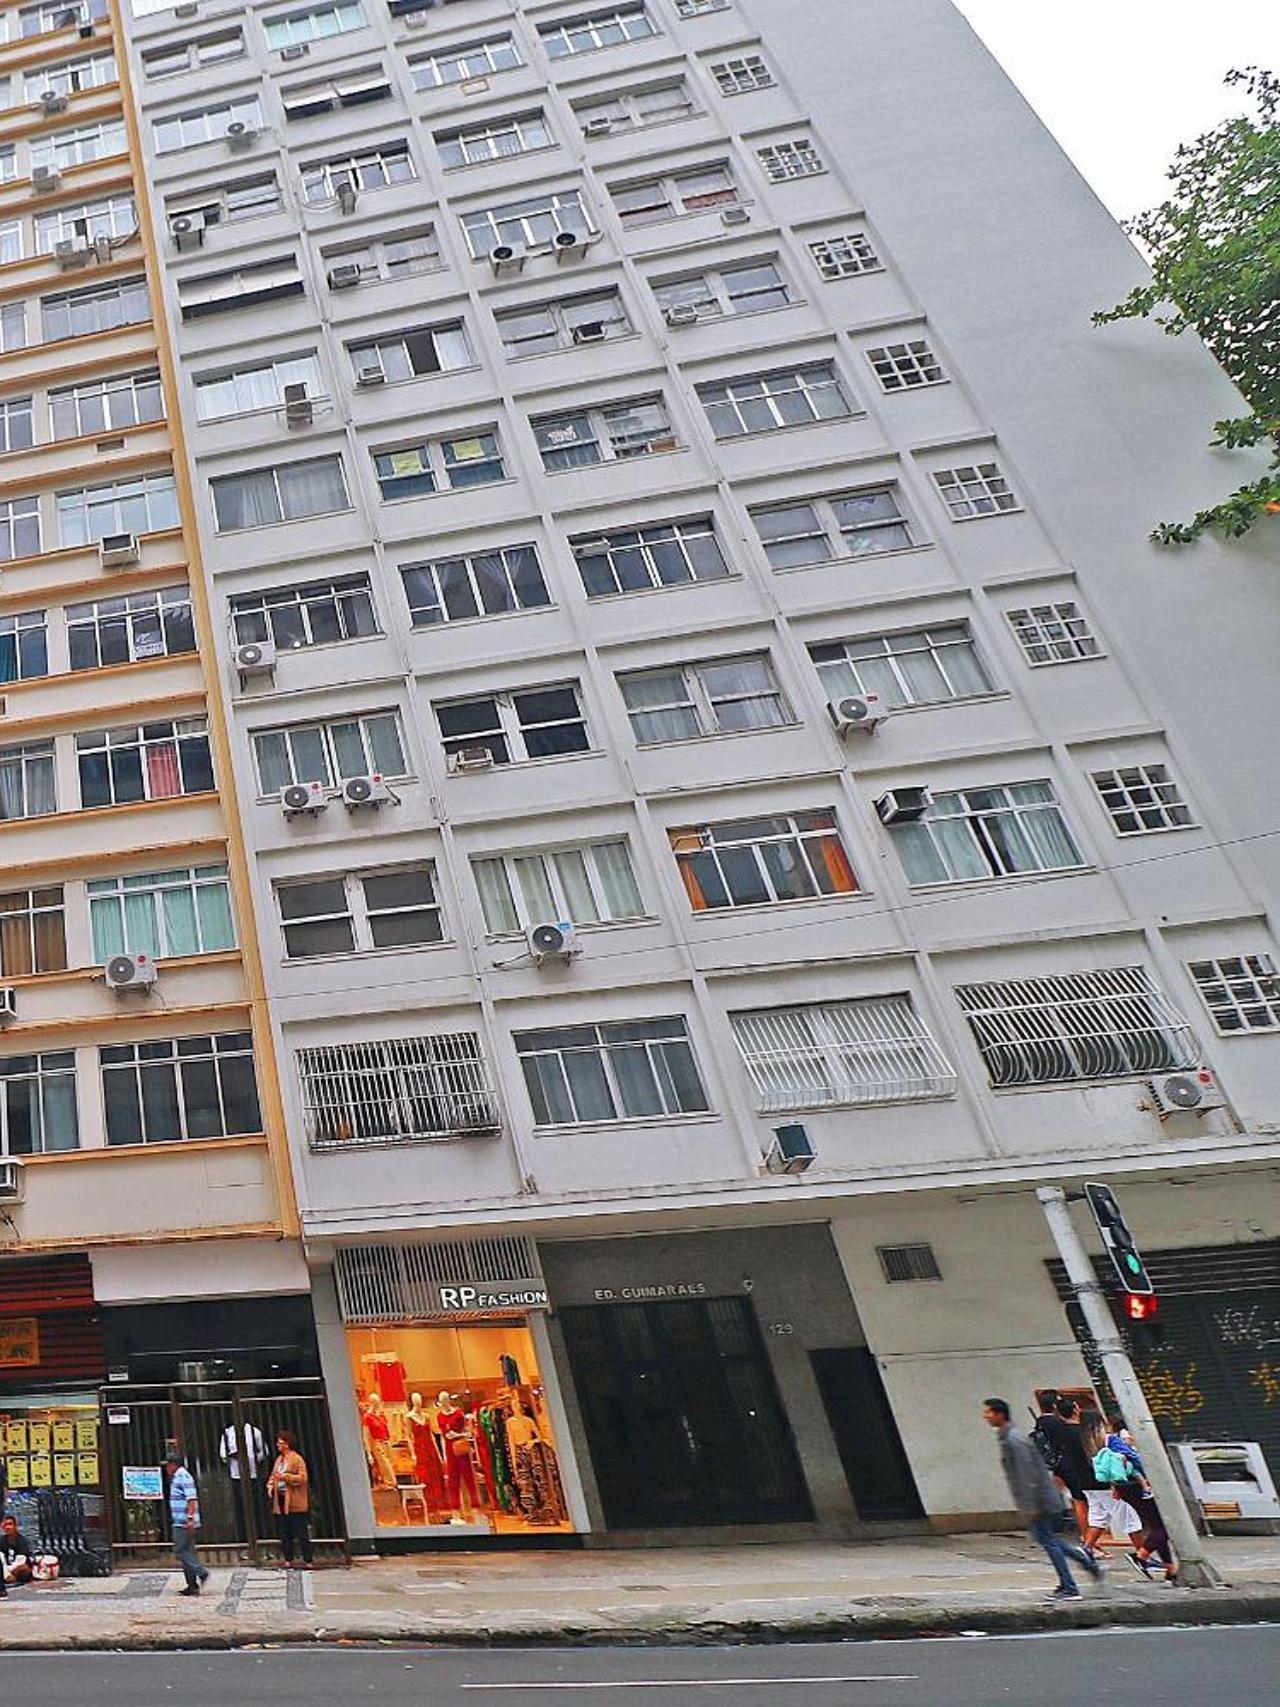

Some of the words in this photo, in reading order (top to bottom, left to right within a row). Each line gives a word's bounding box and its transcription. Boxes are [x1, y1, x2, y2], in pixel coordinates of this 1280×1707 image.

[440, 1287, 475, 1309] RP
[479, 1291, 547, 1307] FASHION
[594, 1289, 617, 1300] ED.
